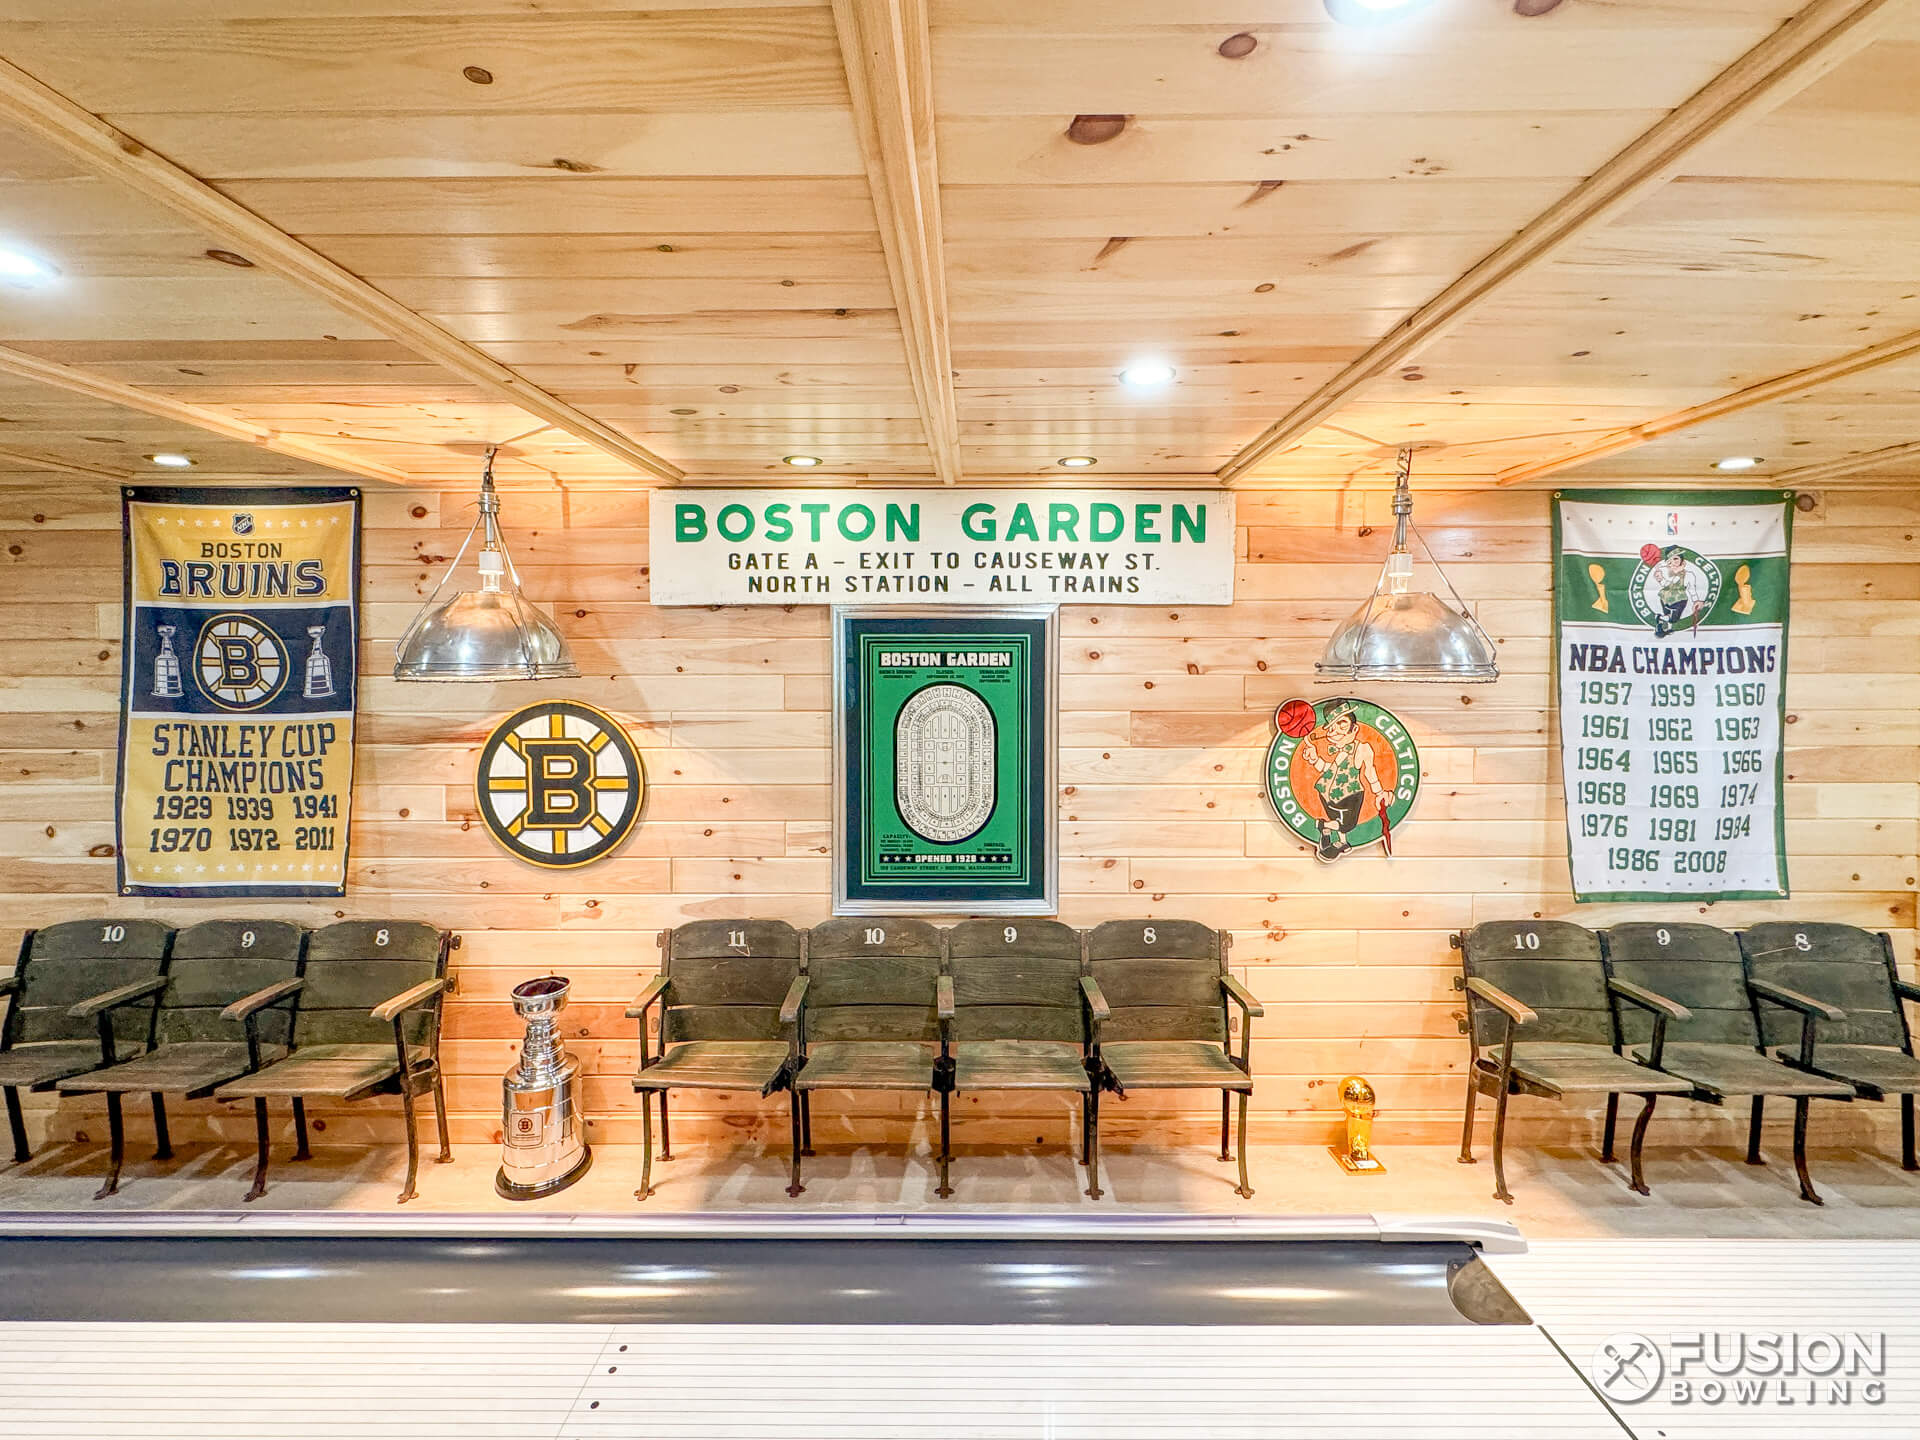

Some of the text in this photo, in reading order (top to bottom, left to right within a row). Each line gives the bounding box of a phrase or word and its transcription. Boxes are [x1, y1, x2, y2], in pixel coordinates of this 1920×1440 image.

[676, 503, 1207, 544] BOSTON GARDEN
[200, 542, 283, 559] BOSTON
[728, 552, 790, 571] GATE
[804, 552, 820, 570] A
[860, 552, 914, 570] EXIT
[930, 552, 960, 570] TO
[974, 552, 1111, 570] CAUSEWAY
[1125, 552, 1162, 571] ST.
[159, 560, 328, 597] BRUINS
[748, 575, 830, 594] NORTH
[845, 575, 950, 593] STATION
[989, 575, 1033, 593] ALL
[1048, 575, 1141, 593] TRAINS
[1632, 564, 1651, 618] BOSTON
[1695, 557, 1719, 608] CELTICS
[214, 635, 261, 690] B
[880, 652, 1010, 666] BOSTON GARDEN
[1568, 643, 1777, 675] NBA CHAMPIONS
[1579, 681, 1766, 707] 1957 1959 1960
[152, 723, 337, 758] STANLEY CUP
[1581, 715, 1760, 741] 1961 1962 1963
[1375, 715, 1415, 801] CELTICS
[1577, 747, 1763, 775] 1964 1965 1966
[164, 759, 325, 794] CHAMPIONS
[520, 738, 598, 829] B
[1273, 739, 1308, 828] BOSTON
[152, 794, 338, 821] 1929 1939 1941
[1577, 781, 1759, 808] 1968 1969 1974
[149, 826, 335, 853] 1970 1972 2011
[1580, 813, 1751, 842] 1976 1981 1984
[1607, 847, 1727, 874] 1986 2008
[101, 925, 125, 942] 10
[241, 930, 256, 948] 9
[375, 929, 389, 946] 8
[727, 930, 747, 947] 11
[863, 928, 885, 945] 10
[1003, 926, 1018, 944] 9
[1142, 927, 1157, 944] 8
[1513, 932, 1540, 950] 10
[1656, 929, 1671, 947] 9
[1794, 933, 1812, 951] 8
